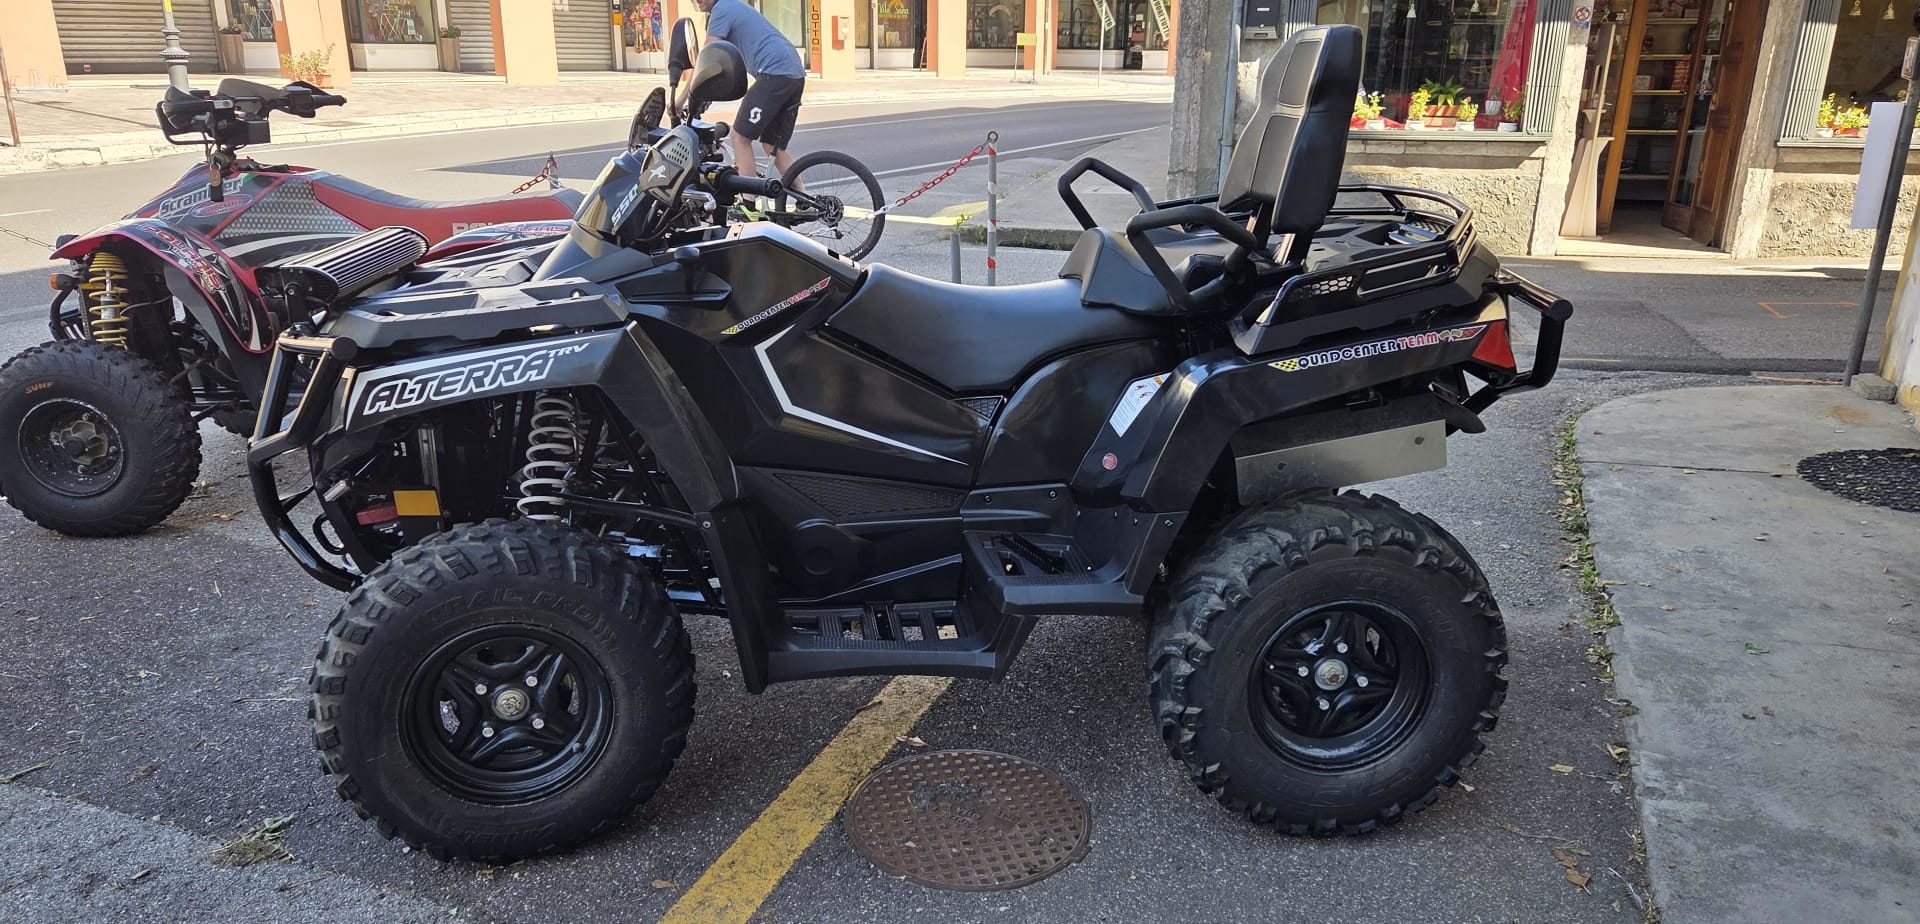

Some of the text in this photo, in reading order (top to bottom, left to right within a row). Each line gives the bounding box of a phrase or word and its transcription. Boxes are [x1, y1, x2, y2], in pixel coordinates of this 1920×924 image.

[811, 4, 820, 46] LOTTO
[611, 183, 638, 227] 550
[362, 342, 591, 416] ALTERRA TRV
